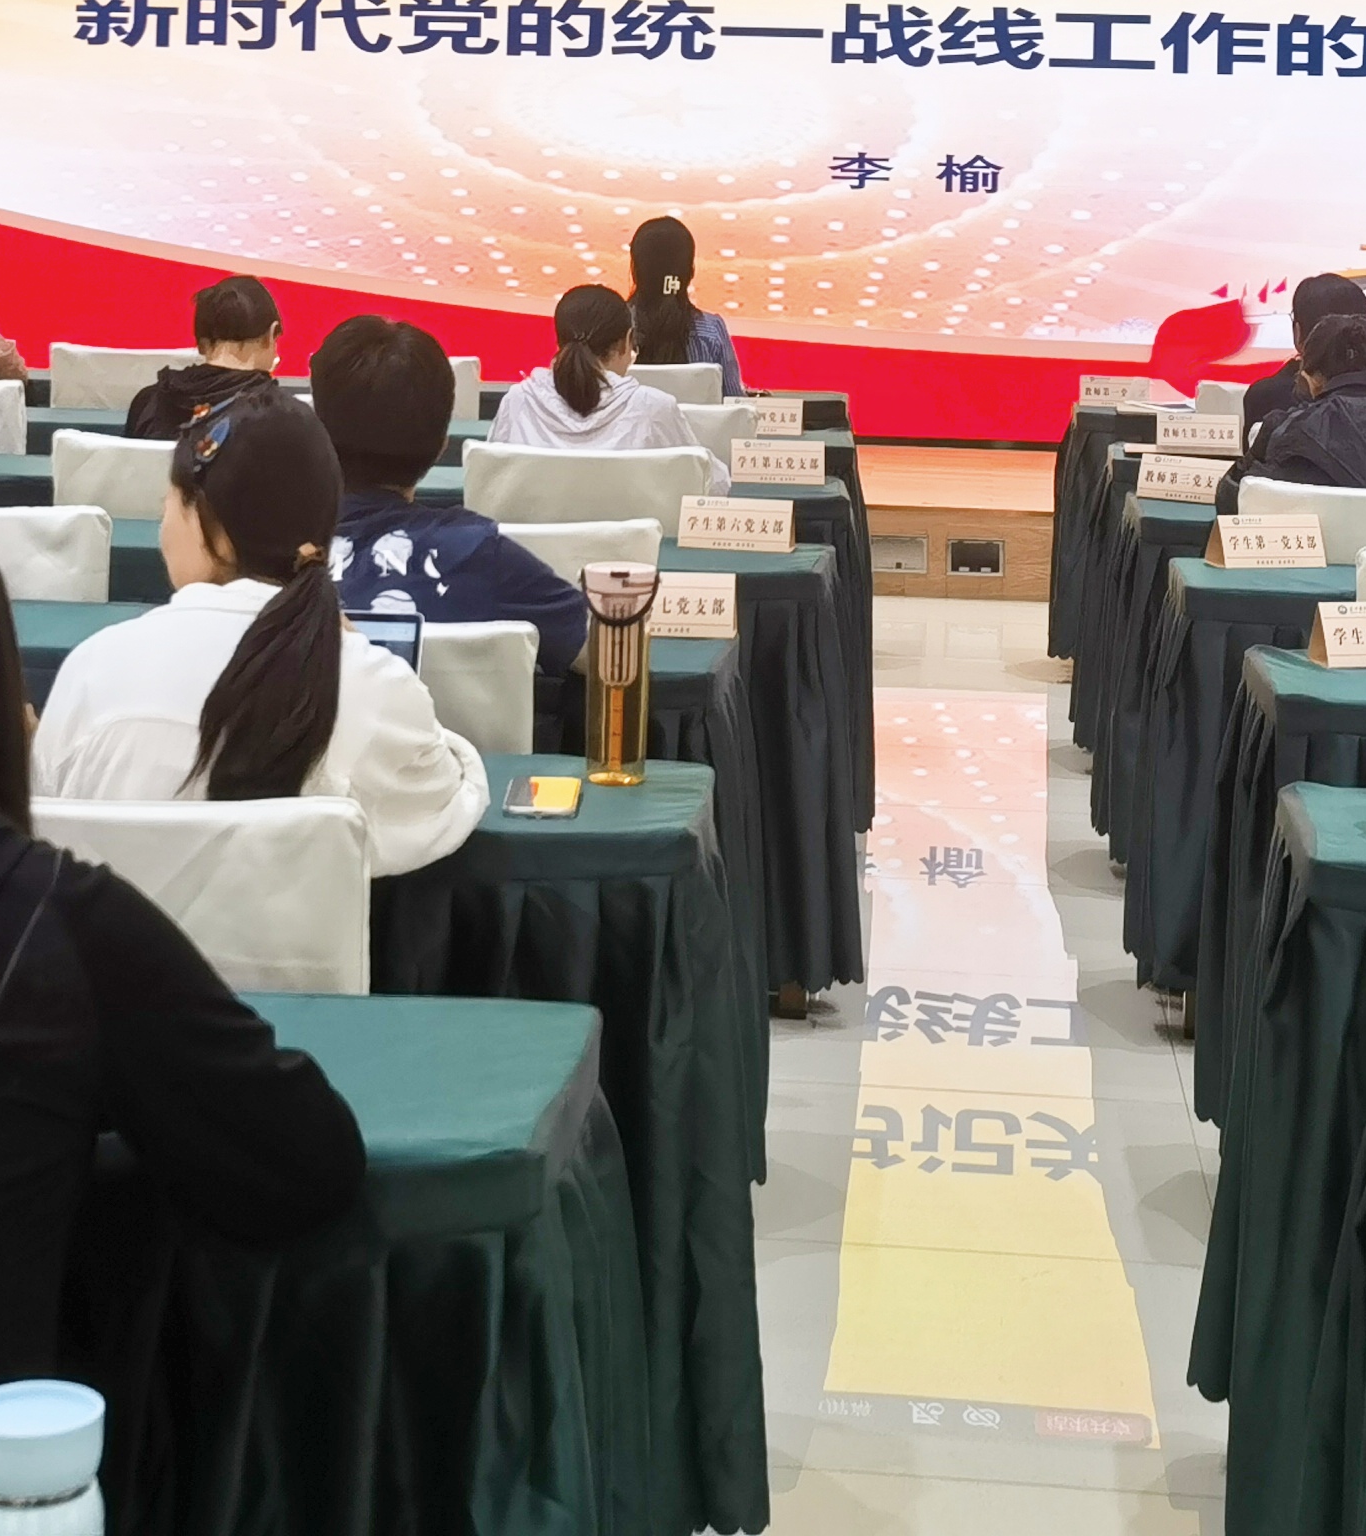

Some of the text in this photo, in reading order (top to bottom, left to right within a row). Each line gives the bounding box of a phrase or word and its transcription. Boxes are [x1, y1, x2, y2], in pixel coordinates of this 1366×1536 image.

[829, 152, 1004, 194] 李 榆
[687, 515, 784, 534] 学生第六党支部
[1229, 534, 1317, 550] 学生第一党支部
